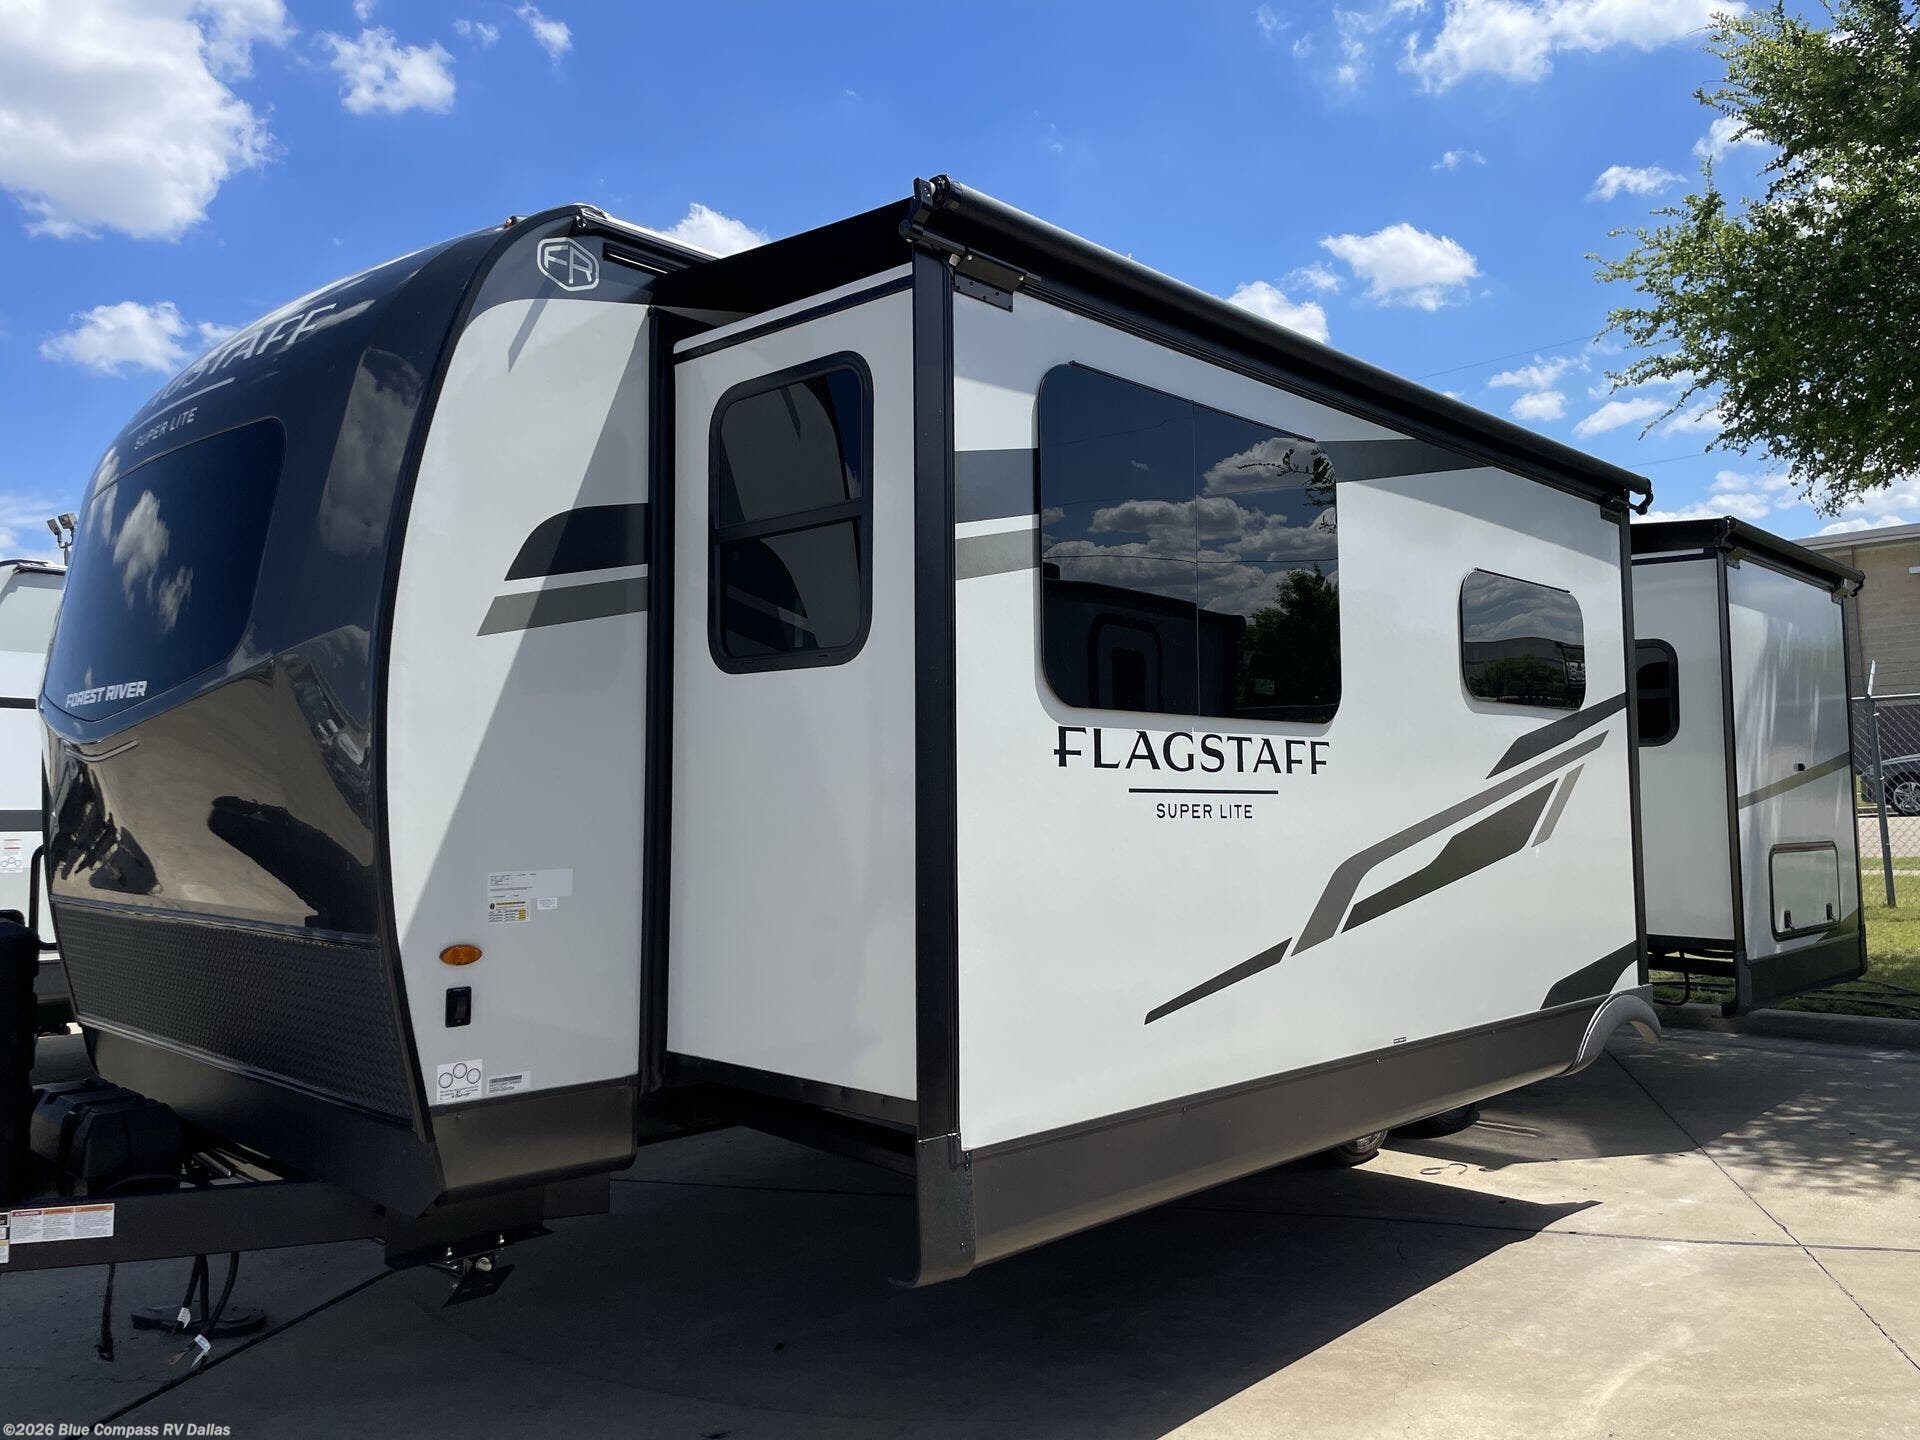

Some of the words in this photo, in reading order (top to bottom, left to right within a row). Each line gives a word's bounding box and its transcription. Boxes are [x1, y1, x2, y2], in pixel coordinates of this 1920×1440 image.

[134, 421, 169, 450] SUPER
[169, 407, 198, 432] LITE
[65, 687, 106, 709] FOREST
[105, 680, 148, 701] RIVER
[1053, 725, 1331, 775] FLAGSTAFF
[1156, 803, 1213, 819] SUPER
[1219, 804, 1253, 819] LITE
